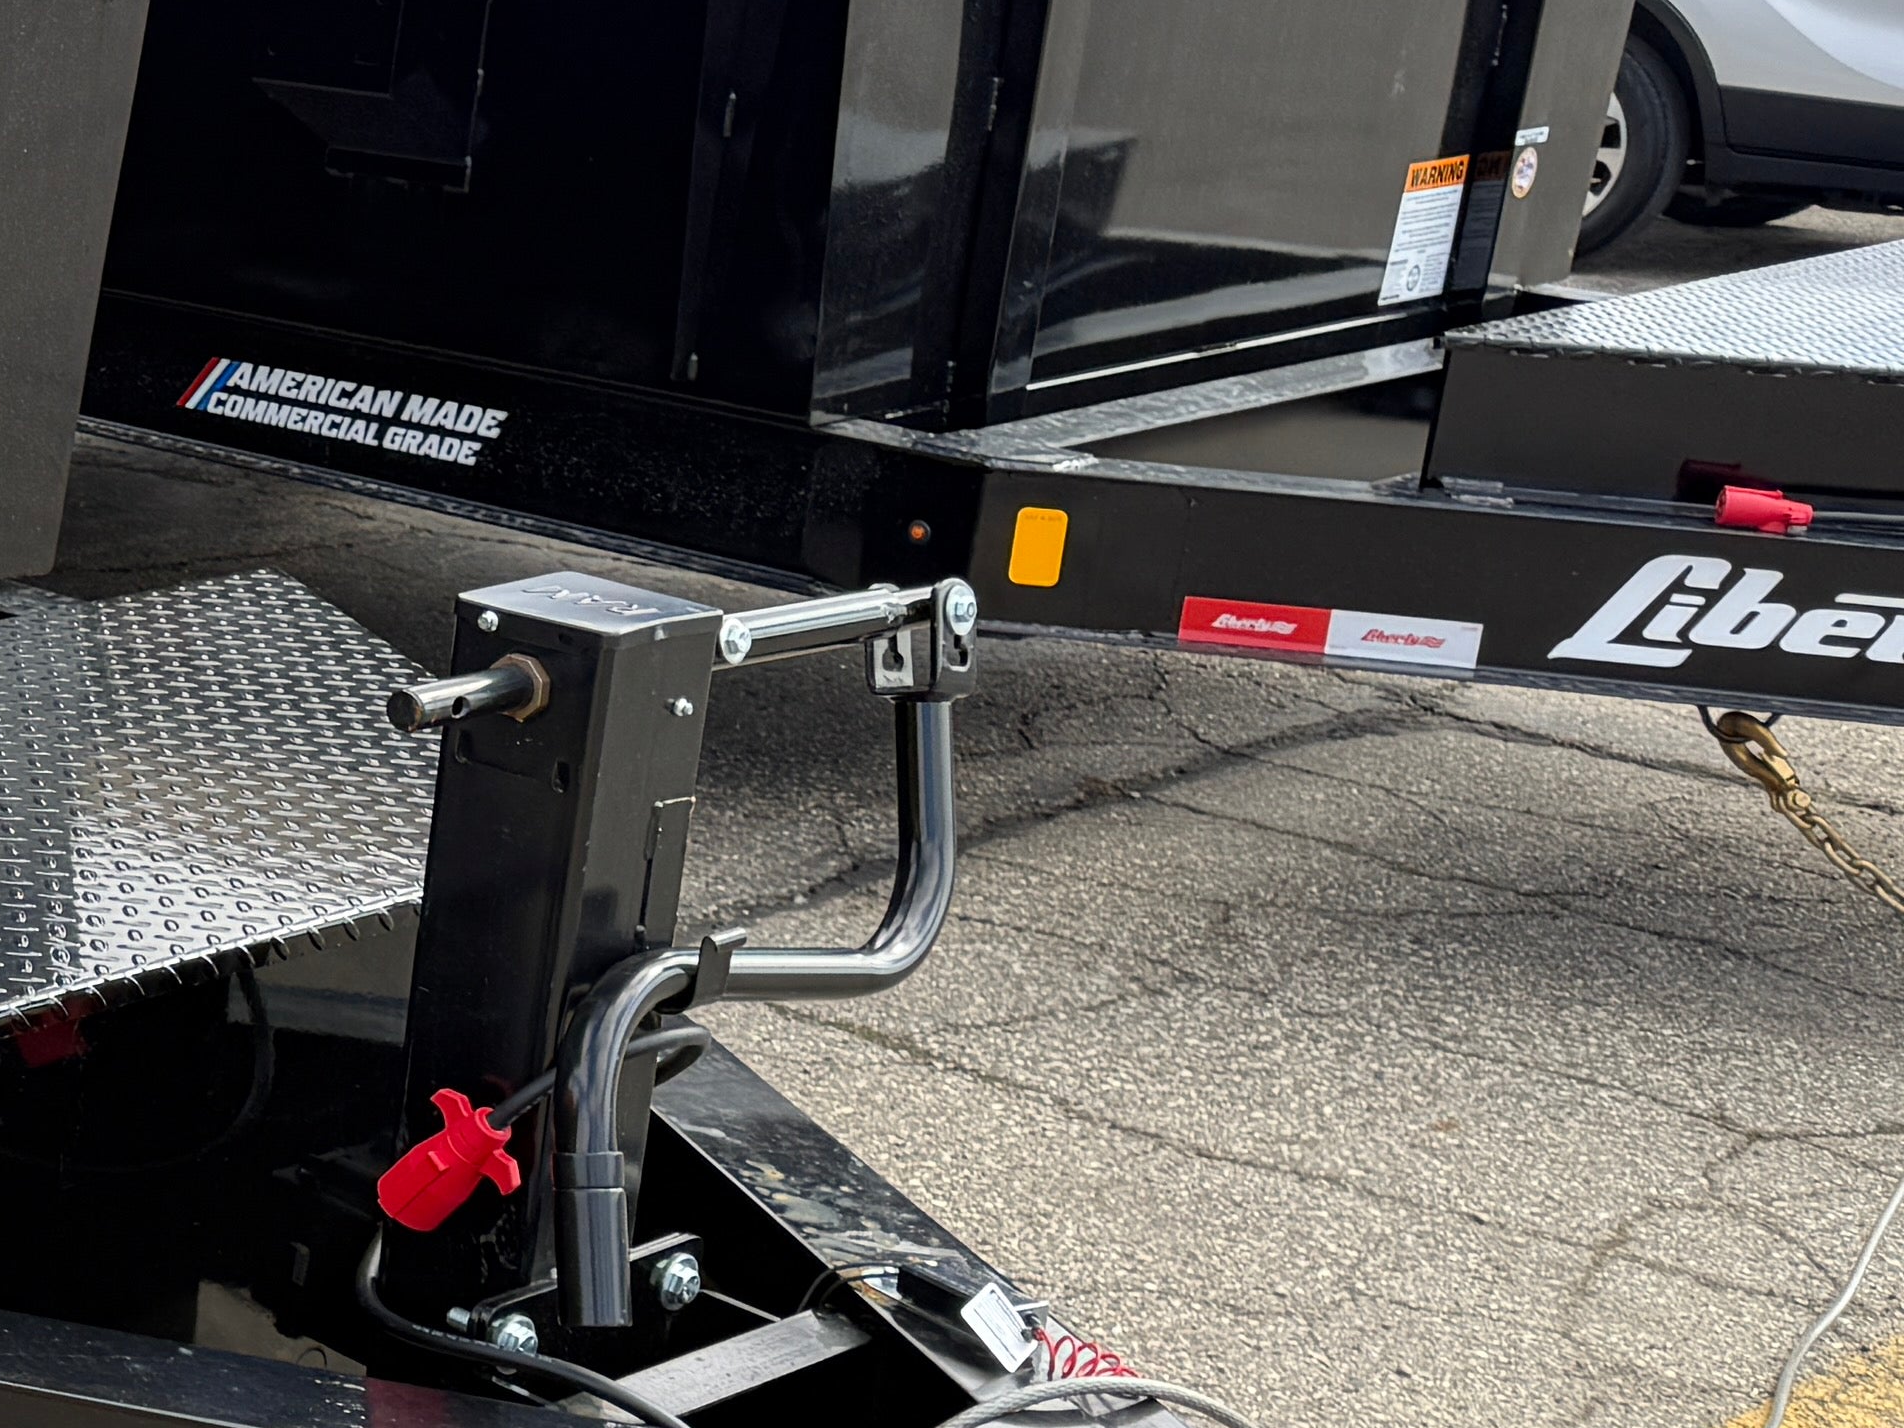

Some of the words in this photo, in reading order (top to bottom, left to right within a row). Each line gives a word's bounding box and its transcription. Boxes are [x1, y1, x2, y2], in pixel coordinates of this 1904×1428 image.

[1411, 161, 1465, 188] WARNING
[207, 391, 379, 447] COMMERCIAL
[382, 427, 482, 466] GRADE
[226, 362, 403, 418] AMERICAN
[401, 394, 508, 439] MADE
